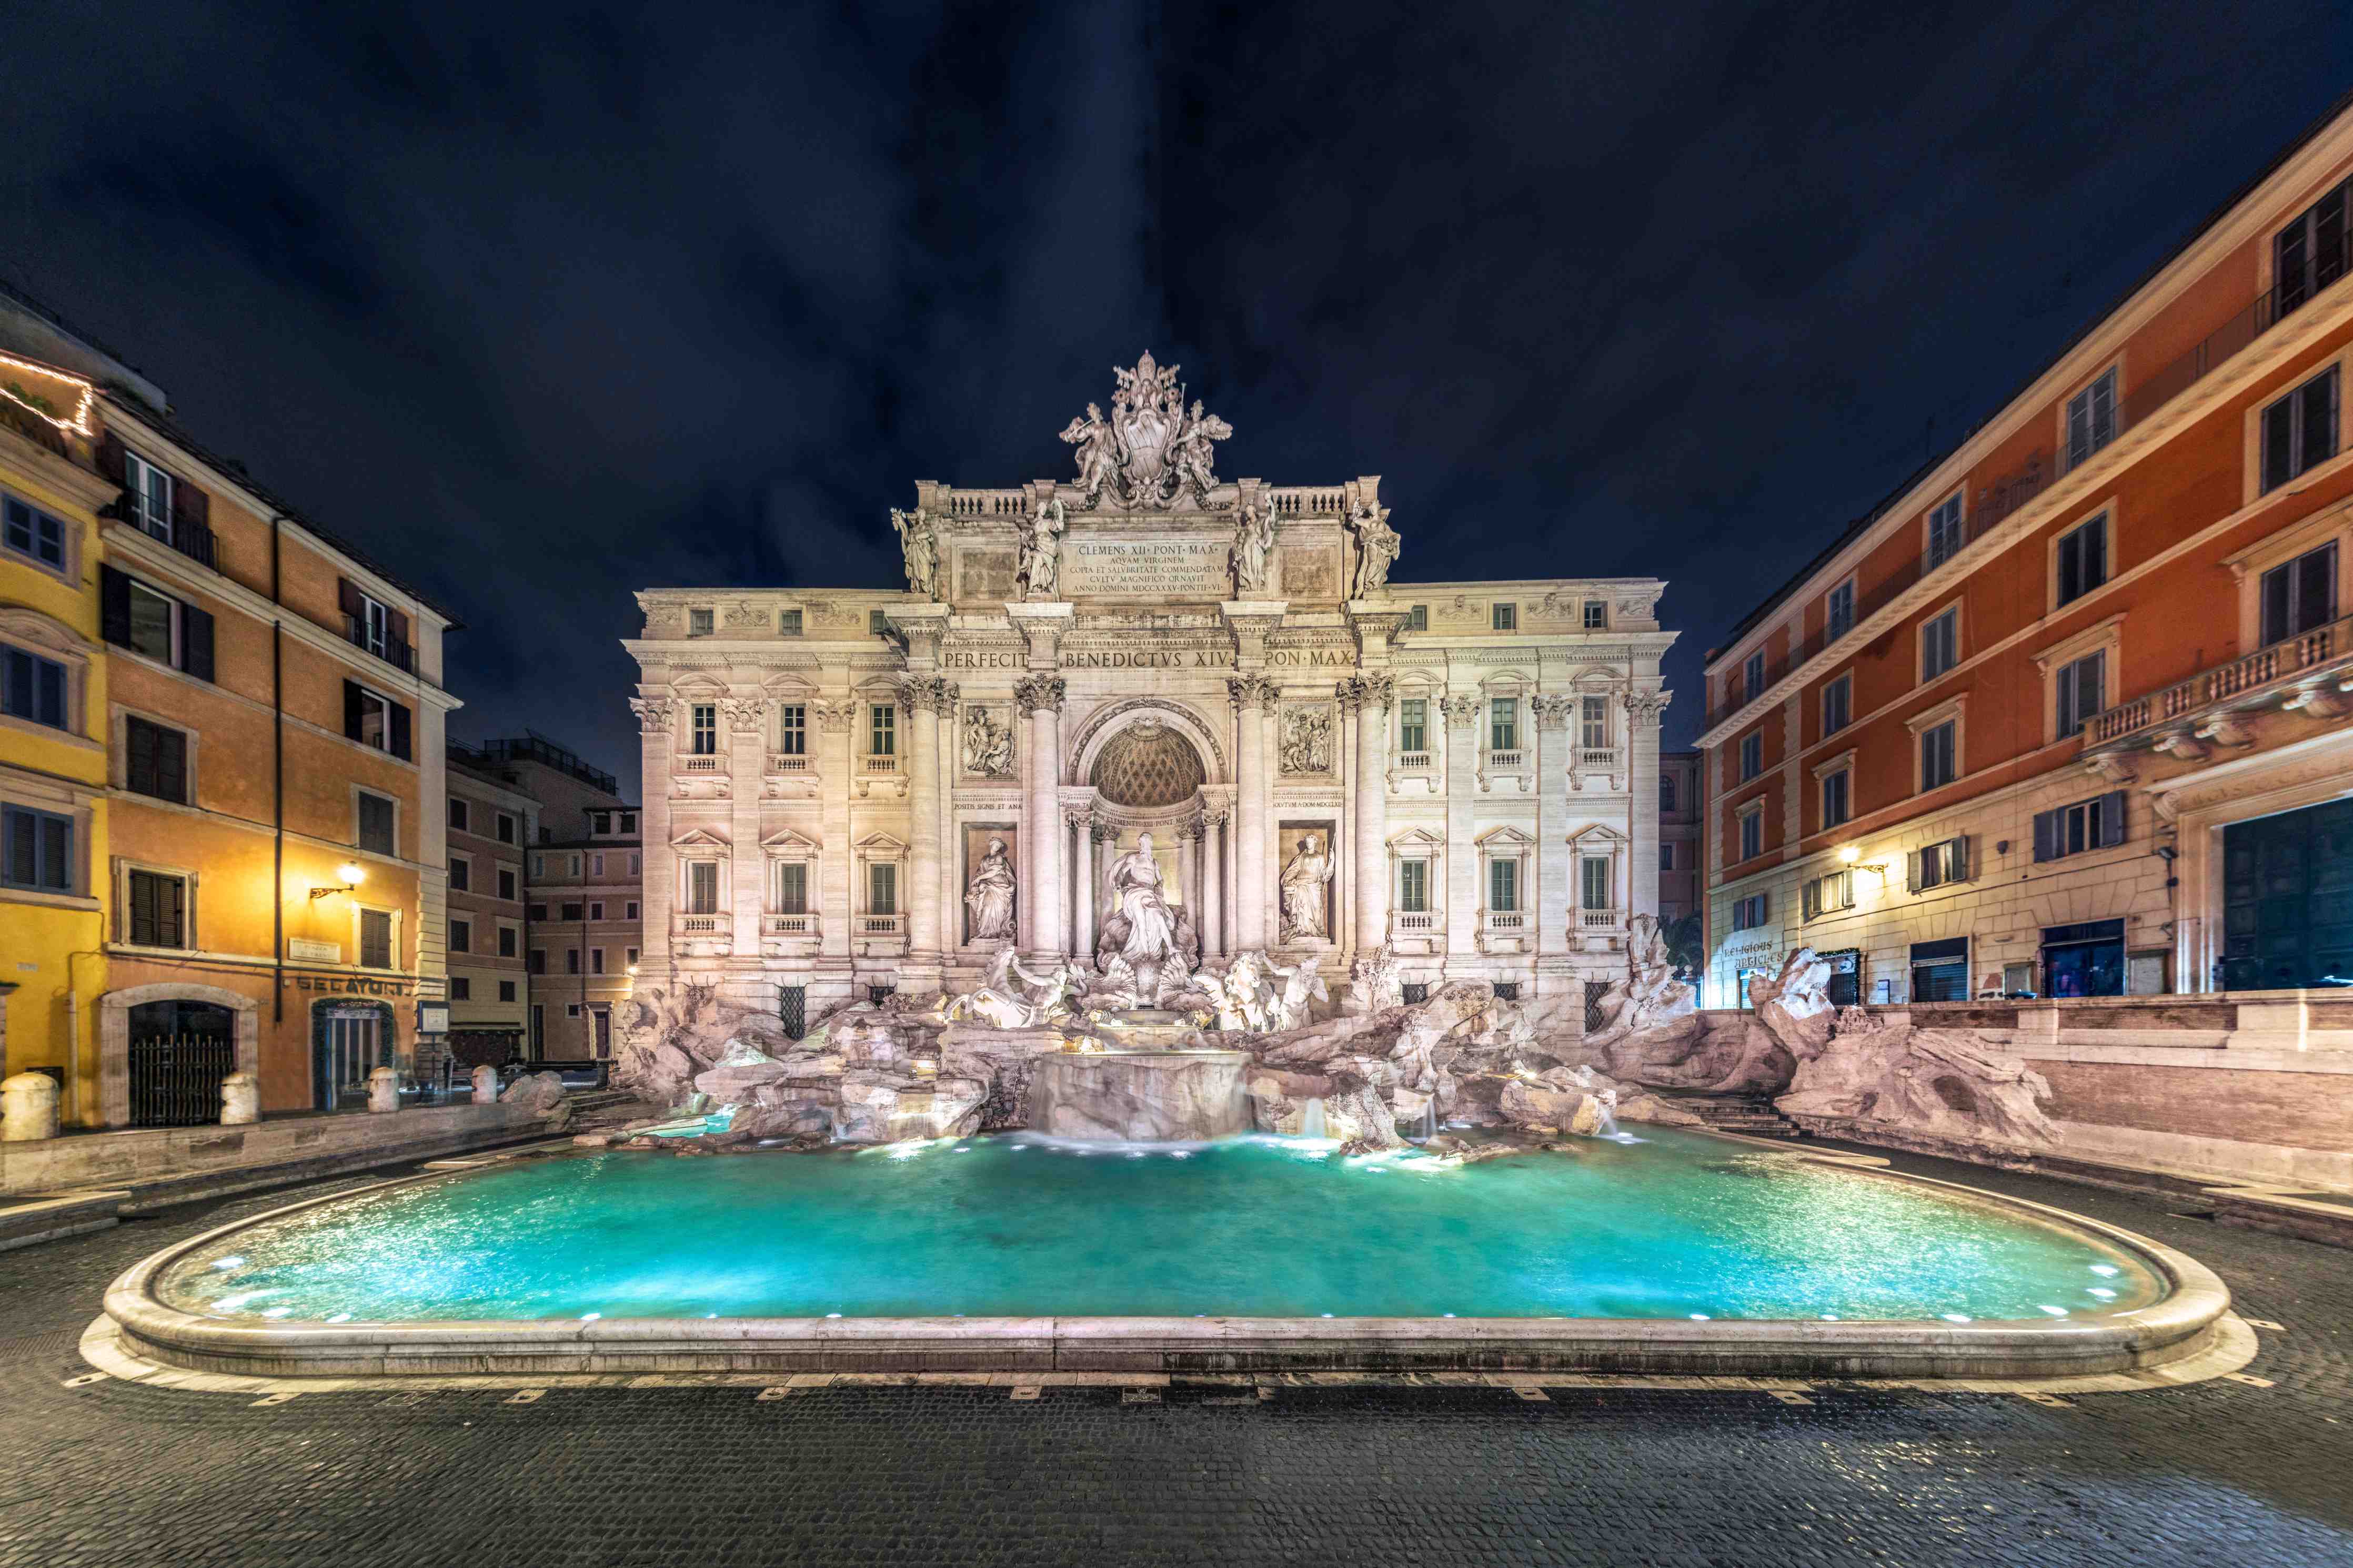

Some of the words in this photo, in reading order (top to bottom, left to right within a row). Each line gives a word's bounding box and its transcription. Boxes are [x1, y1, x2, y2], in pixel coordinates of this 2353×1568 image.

[1079, 545, 1125, 555] CLEMENS
[1110, 557, 1139, 565] AQVAM
[944, 653, 1029, 667] PERFECIT
[1065, 652, 1182, 667] BENEDICTVS
[1724, 940, 1773, 957] RELIGIOUS
[1734, 952, 1783, 968] ARTICLES
